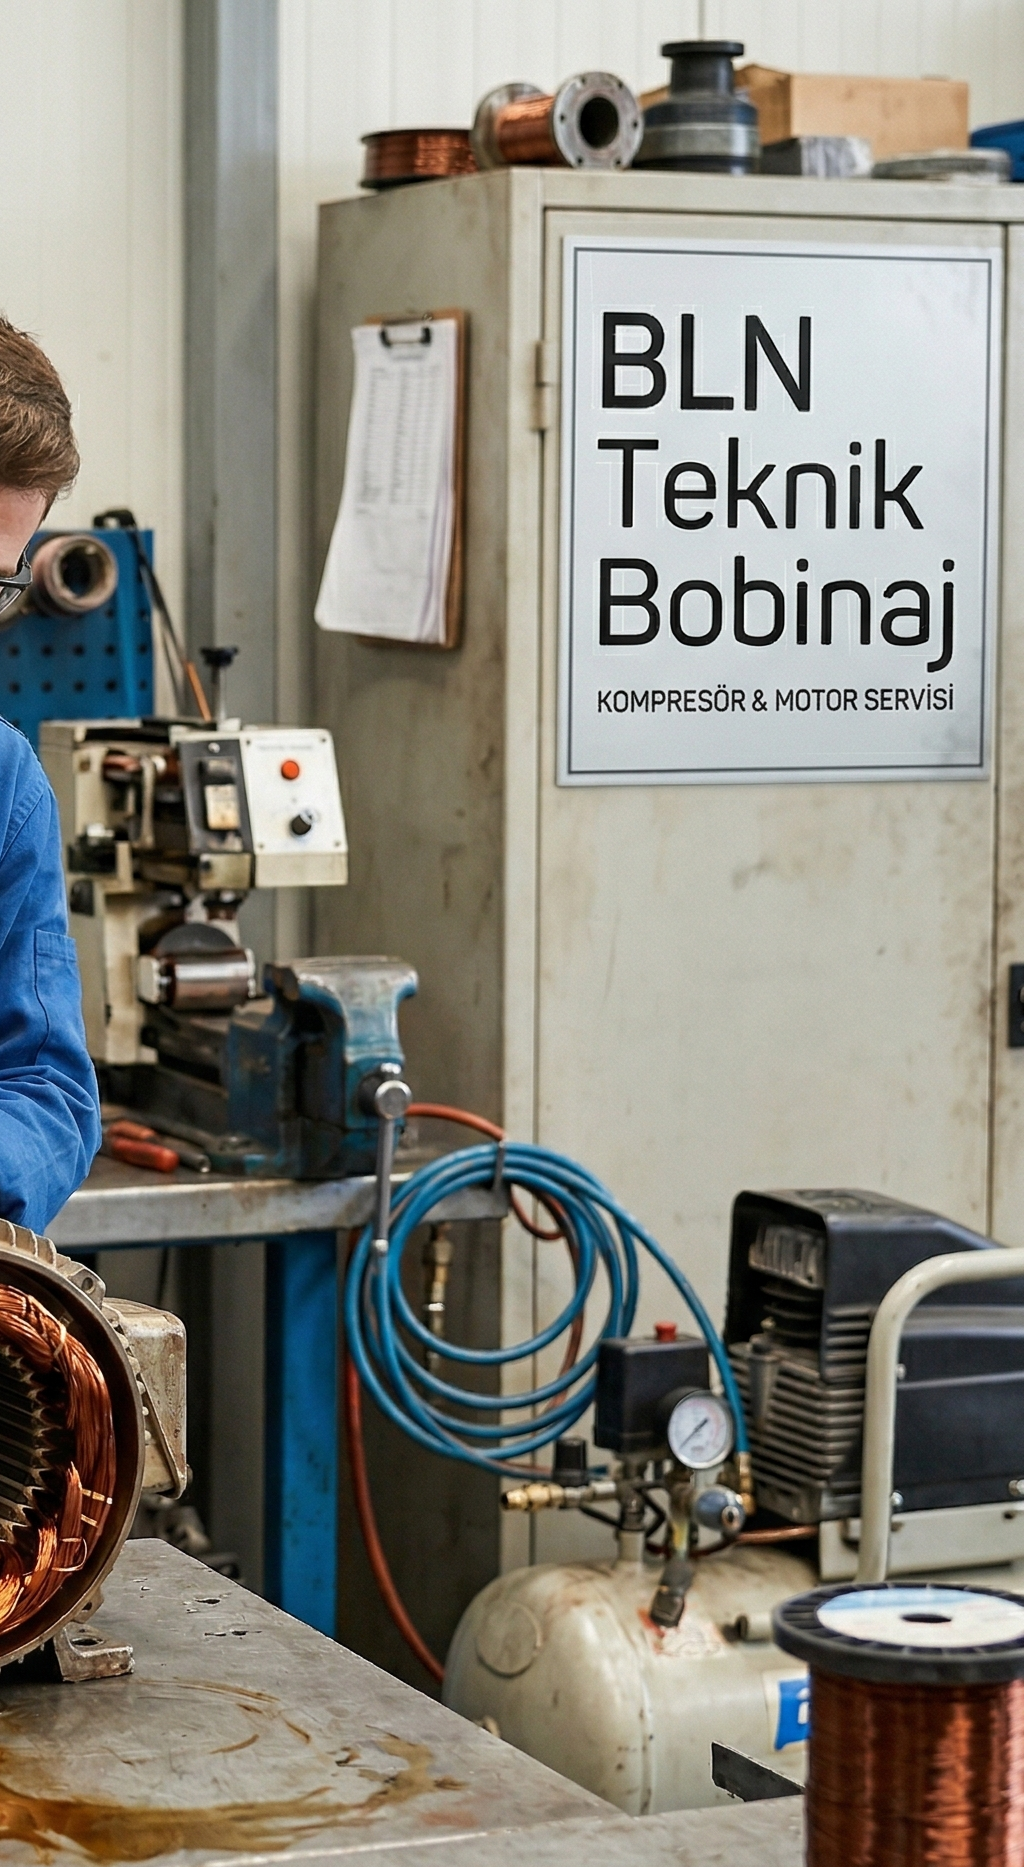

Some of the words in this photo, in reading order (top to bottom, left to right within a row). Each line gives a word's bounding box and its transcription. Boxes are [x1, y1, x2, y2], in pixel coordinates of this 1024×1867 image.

[602, 312, 811, 412] BLN
[598, 437, 924, 530] Teknik
[599, 556, 955, 673] Bobinaj
[597, 683, 746, 713] KOMPRESÖR
[751, 688, 768, 712] &
[775, 688, 858, 712] MOTOR
[864, 682, 954, 711] SERVİSİ
